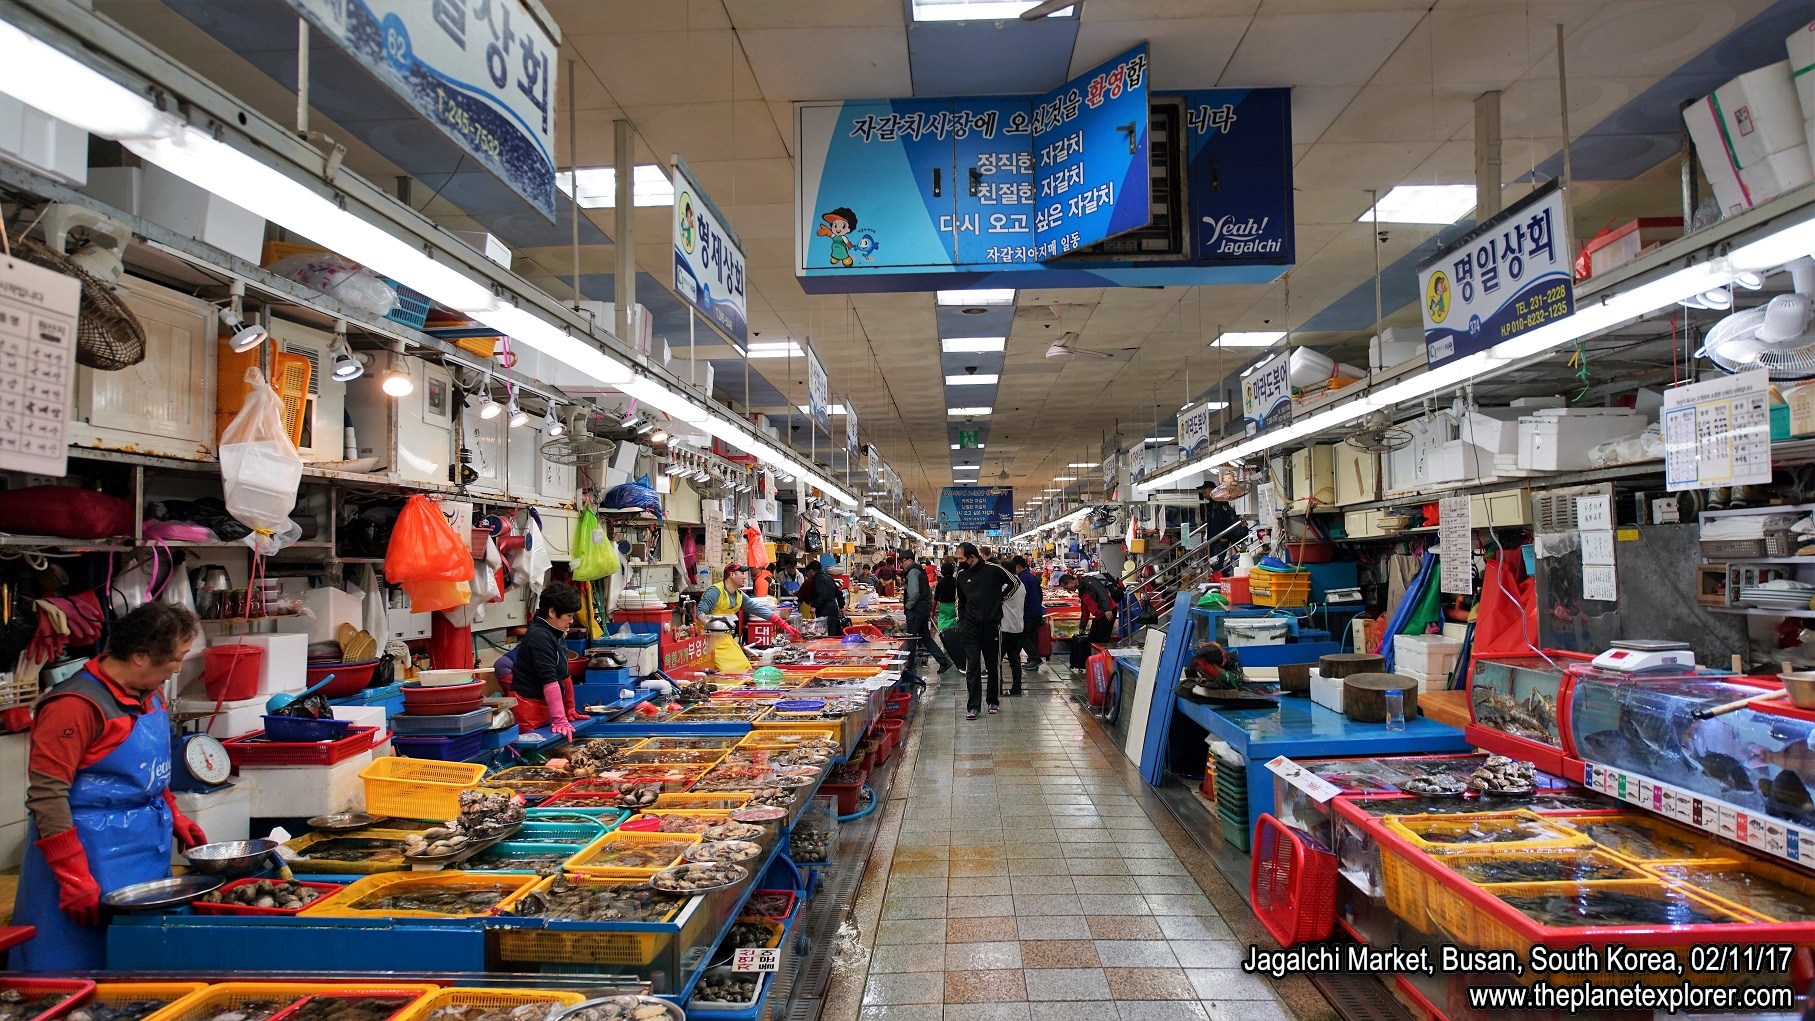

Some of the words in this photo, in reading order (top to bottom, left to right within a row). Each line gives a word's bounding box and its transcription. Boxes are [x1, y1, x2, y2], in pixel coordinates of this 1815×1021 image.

[387, 27, 405, 64] 62
[436, 88, 501, 161] T.245-7532
[850, 110, 998, 142] 자갈치시장에
[1003, 89, 1081, 136] 오신것을
[977, 152, 1035, 175] 정직한
[1040, 130, 1083, 167] 자갈치
[977, 182, 1036, 205] 친절한
[1041, 162, 1084, 198] 자갈치
[939, 212, 980, 236] 다시
[987, 213, 1029, 233] 오고
[1035, 203, 1063, 233] 싶은
[1068, 181, 1114, 218] 자갈치
[986, 240, 1057, 263] 자갈치아지매
[1060, 231, 1081, 251] 일동
[1202, 214, 1269, 245] Yeah!
[1217, 238, 1282, 255] Jagalchi
[697, 212, 745, 307] 형제상회
[1453, 207, 1555, 303] 명일상회
[1530, 284, 1566, 311] 231-2228
[1469, 319, 1481, 335] 374
[1511, 302, 1568, 334] 010-8232-1235
[1253, 360, 1288, 405] 마라도복어
[737, 949, 756, 971] 자연산
[758, 949, 776, 970] 돌문어
